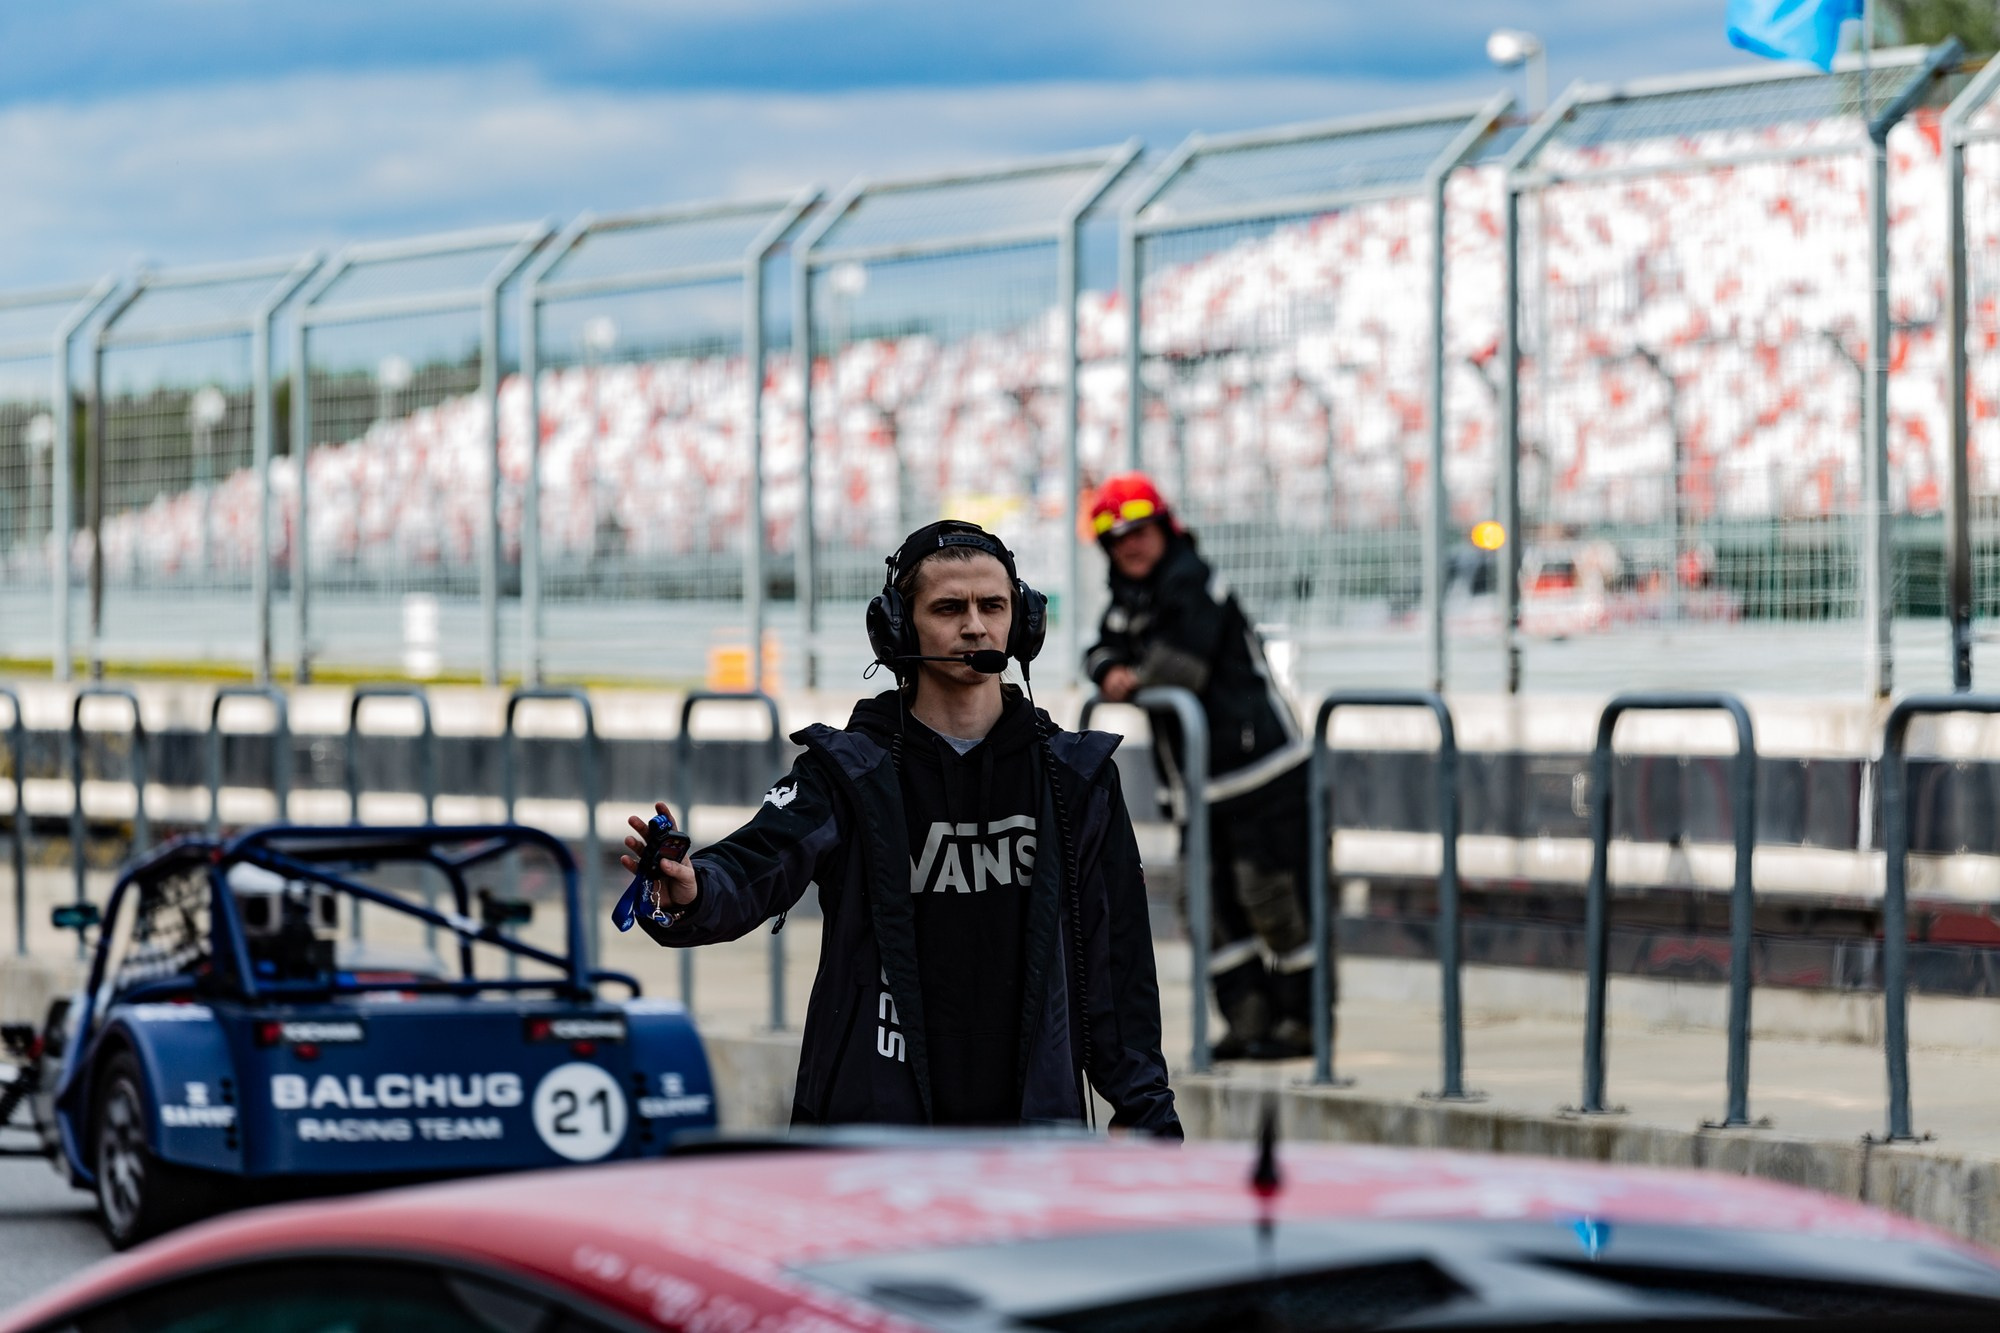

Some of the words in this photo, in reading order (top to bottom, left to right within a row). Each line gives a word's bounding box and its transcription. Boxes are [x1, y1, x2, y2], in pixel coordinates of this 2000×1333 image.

[909, 814, 1037, 894] VANS
[271, 1073, 523, 1109] BALCHUG
[298, 1118, 412, 1142] RACING
[418, 1117, 503, 1140] TEAM
[551, 1090, 613, 1135] 21
